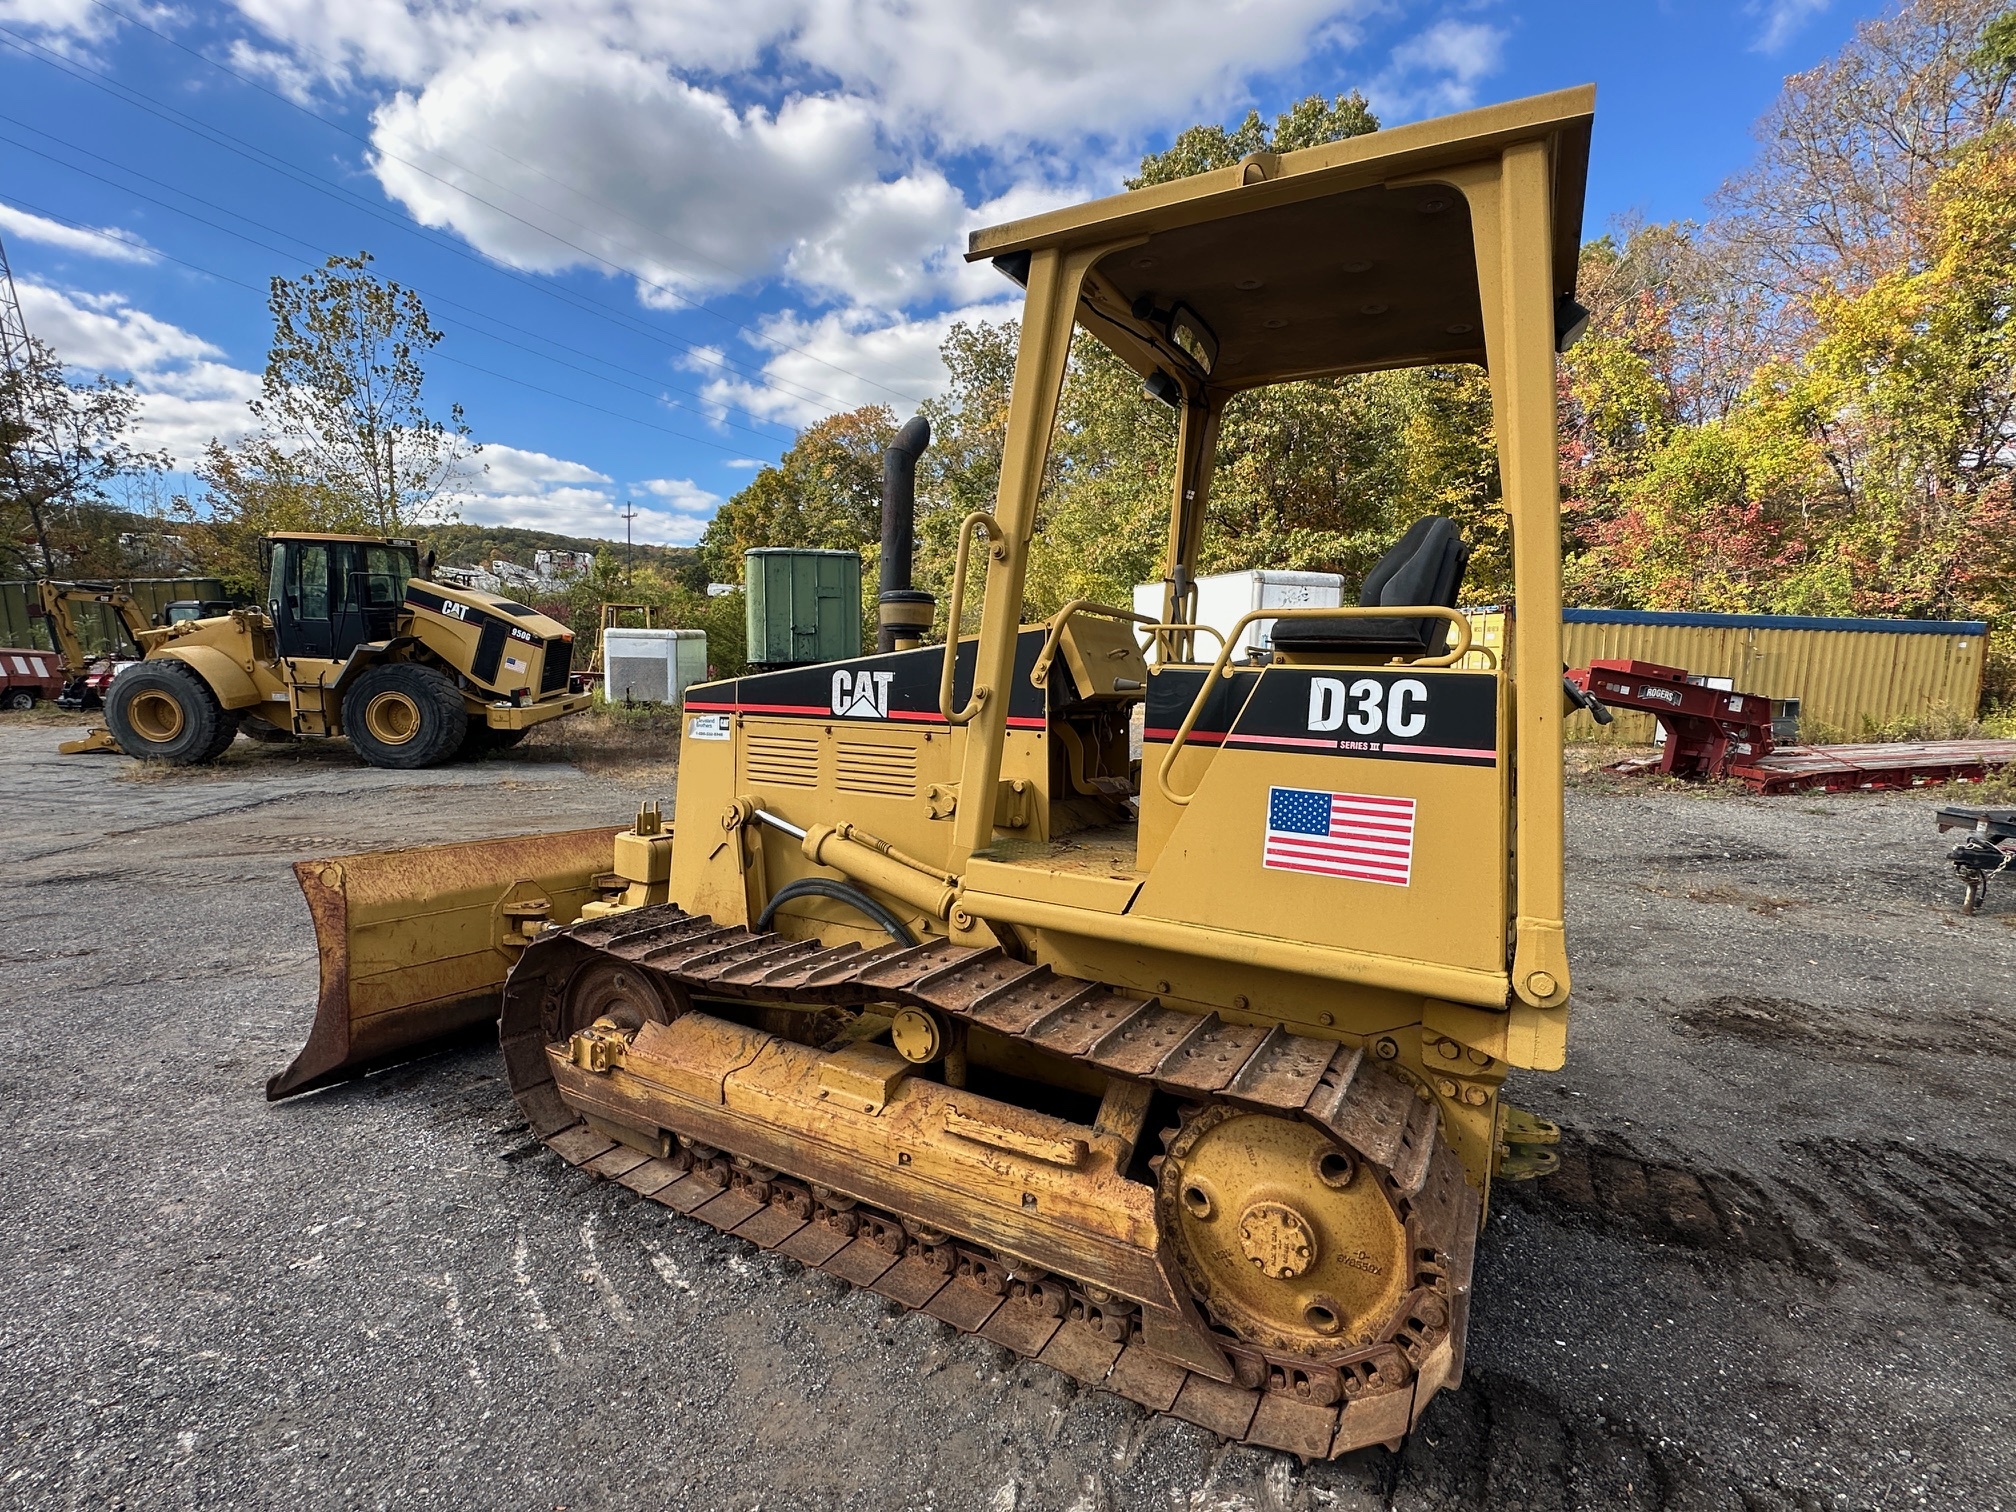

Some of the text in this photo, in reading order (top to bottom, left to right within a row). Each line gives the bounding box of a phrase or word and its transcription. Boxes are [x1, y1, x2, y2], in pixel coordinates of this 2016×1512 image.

[441, 600, 470, 620] CAT
[511, 628, 531, 641] 950G
[831, 669, 894, 718] CAT
[1646, 688, 1674, 702] ROGERS
[1307, 677, 1428, 738] D3C
[1340, 740, 1368, 751] SERIES
